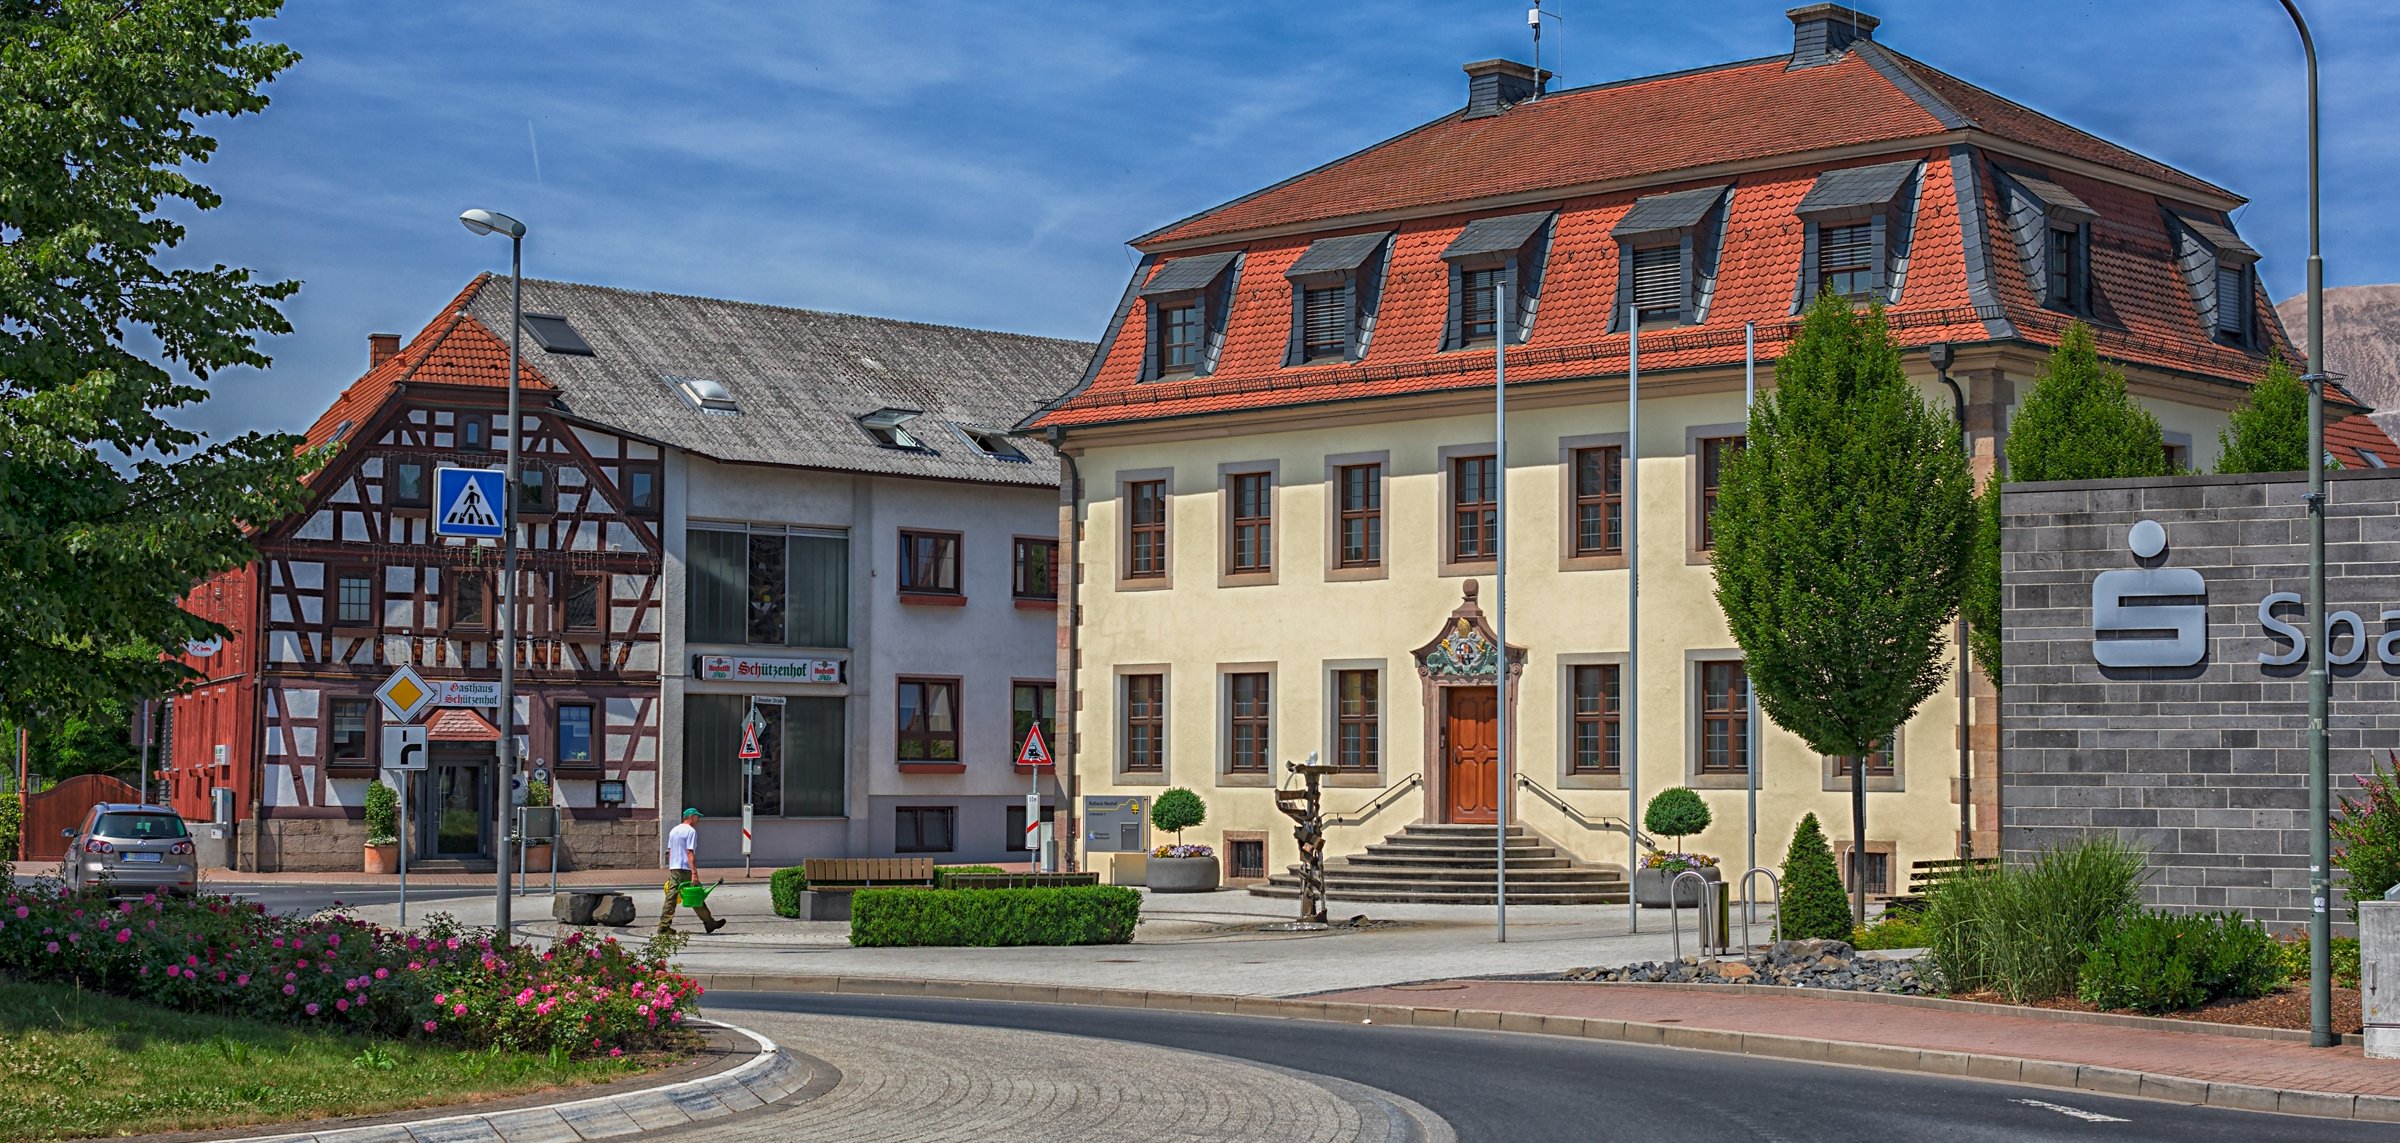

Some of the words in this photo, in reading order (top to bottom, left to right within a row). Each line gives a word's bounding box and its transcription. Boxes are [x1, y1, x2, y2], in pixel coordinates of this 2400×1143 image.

[738, 661, 807, 679] Schützenhof
[450, 683, 494, 694] Gasthaus
[445, 694, 498, 705] Schützenhof
